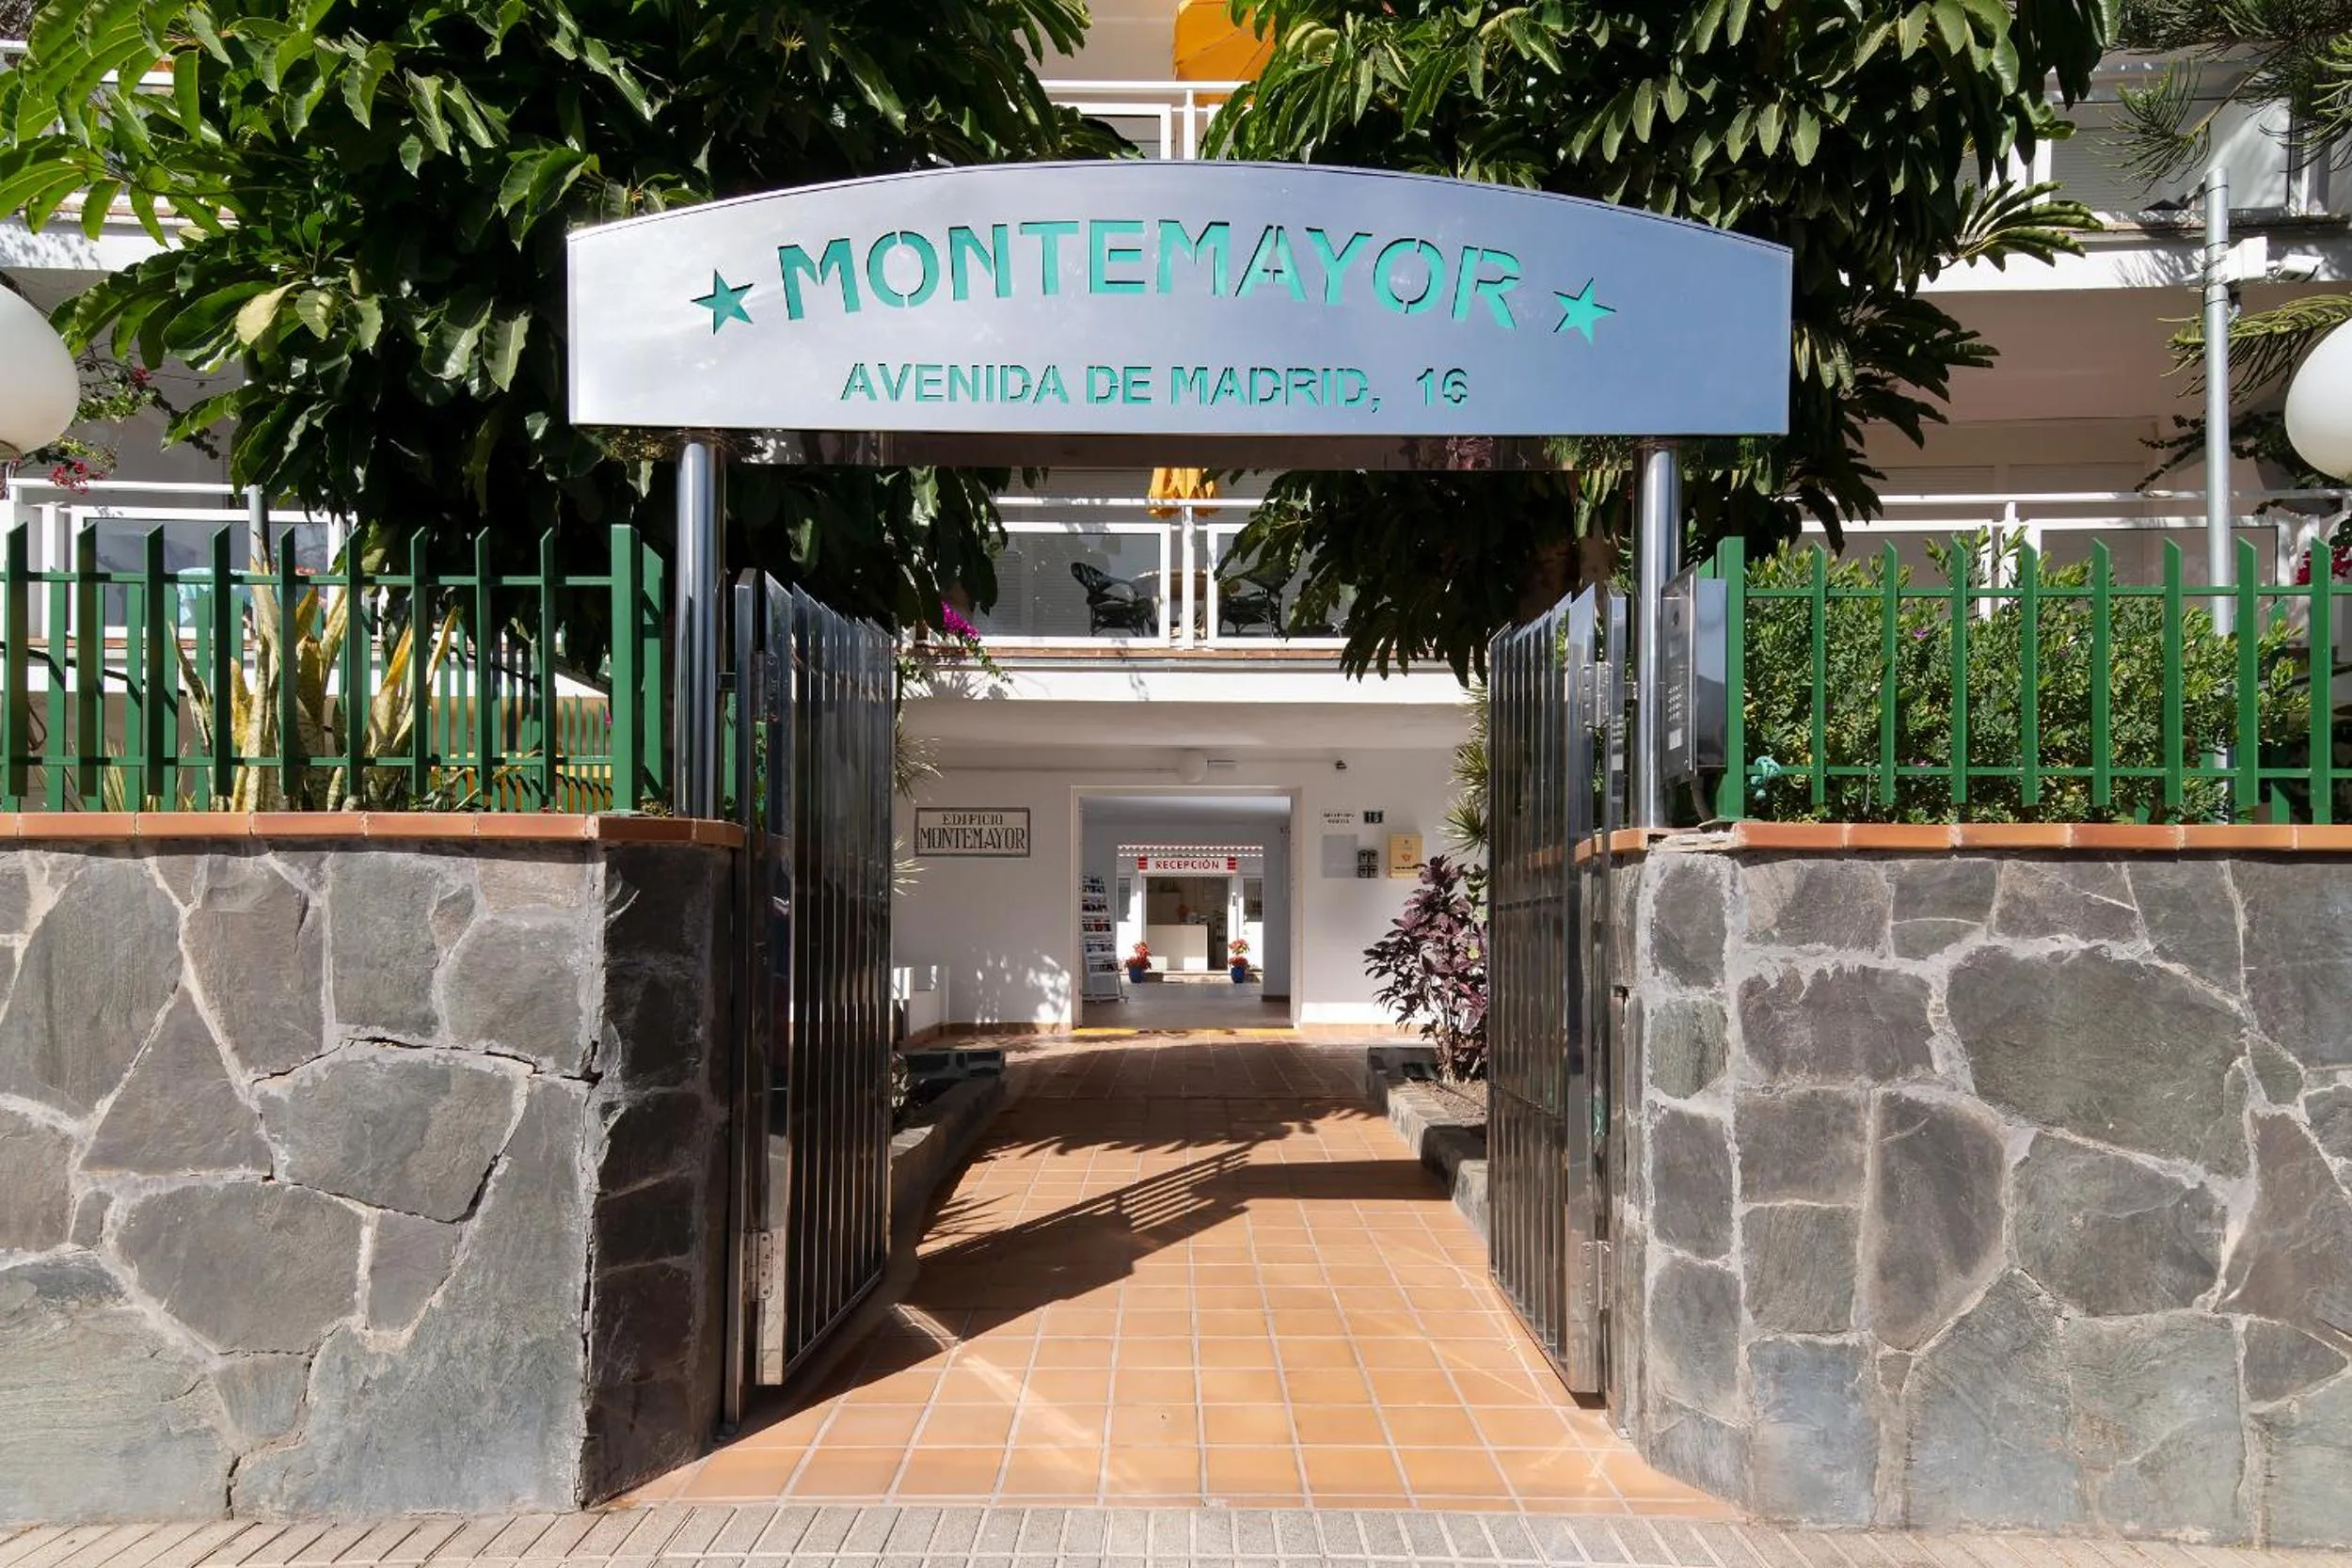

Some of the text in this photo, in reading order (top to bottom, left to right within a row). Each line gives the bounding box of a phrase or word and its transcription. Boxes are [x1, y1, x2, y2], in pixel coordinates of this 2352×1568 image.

[777, 219, 1522, 330] MONTEMAYOR
[840, 363, 1469, 413] AVENIDA DE MADRID, 16
[942, 813, 1003, 825] EDIFICIO
[920, 827, 1025, 849] MONTEMAYOR
[1156, 859, 1219, 869] RECEPCIÓN
